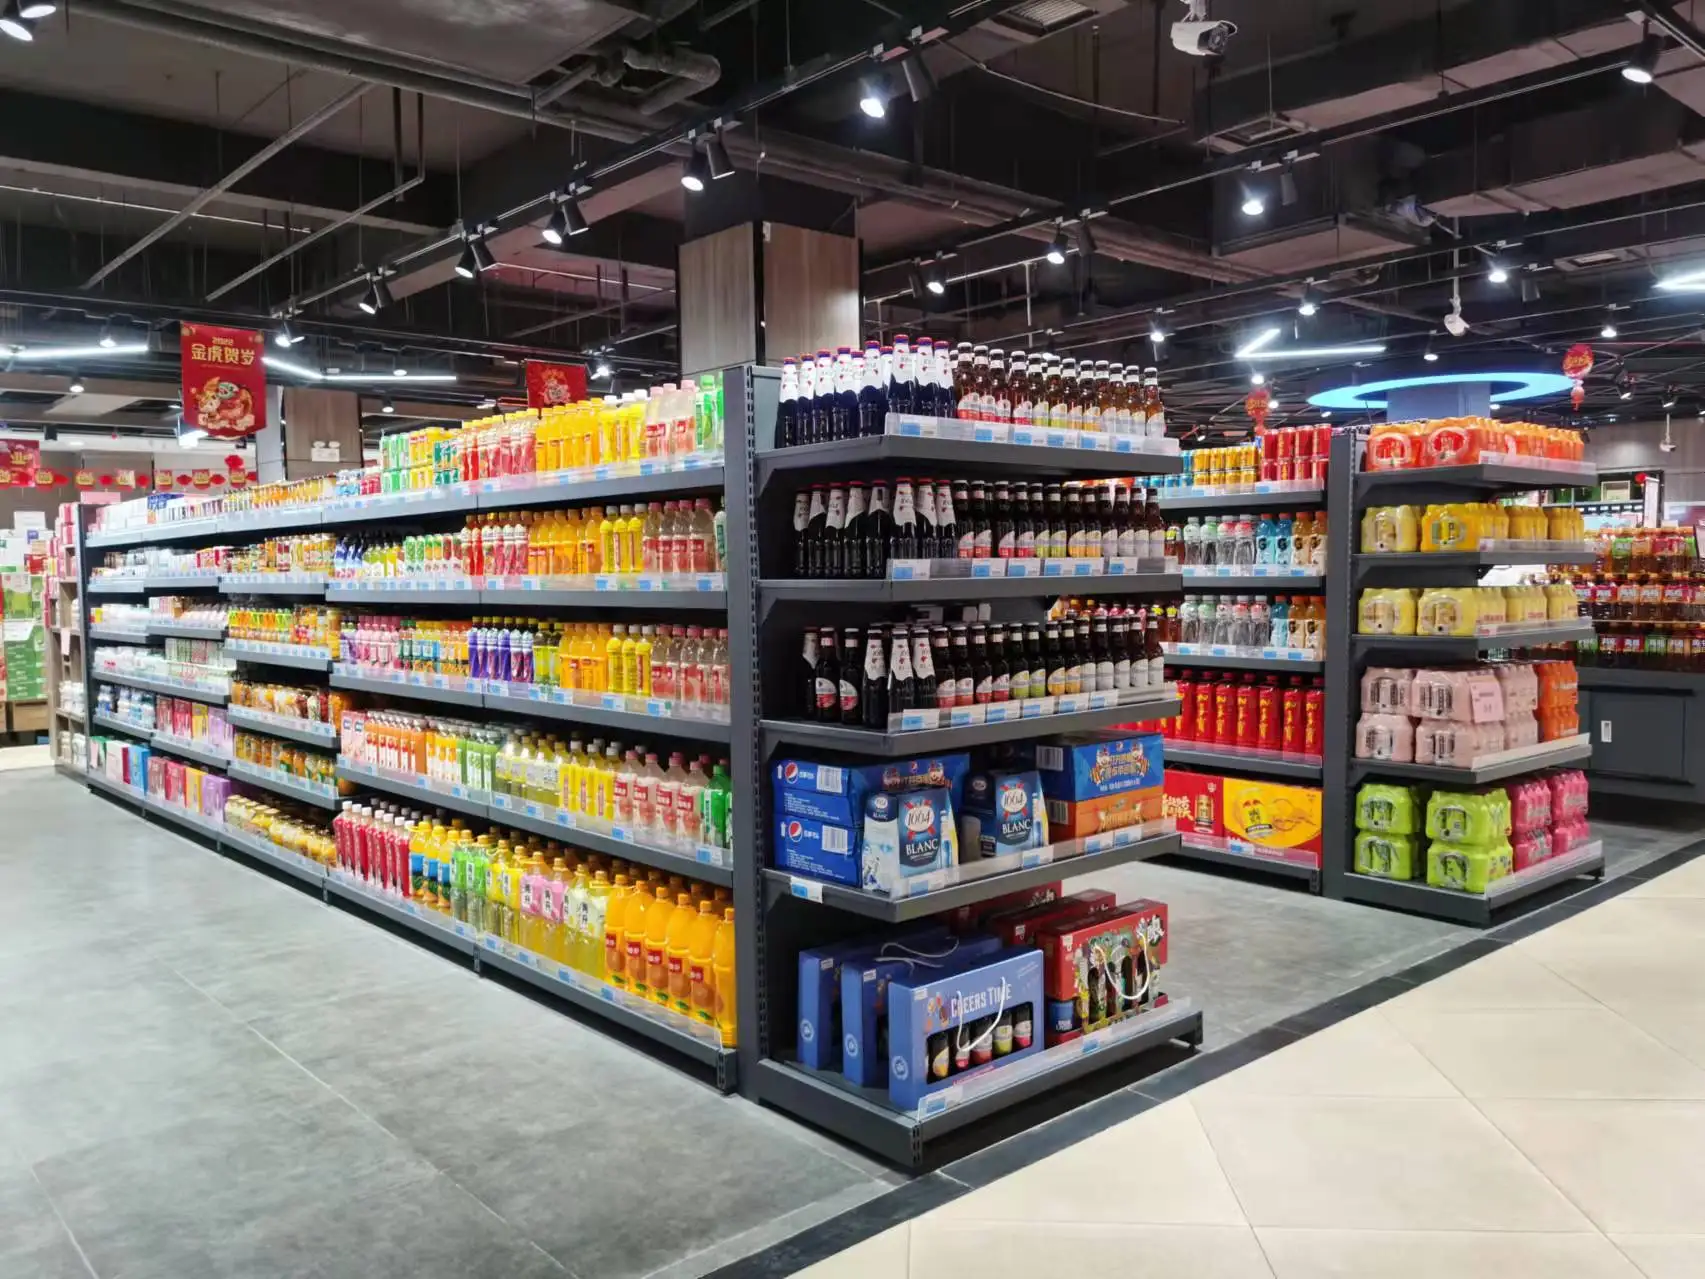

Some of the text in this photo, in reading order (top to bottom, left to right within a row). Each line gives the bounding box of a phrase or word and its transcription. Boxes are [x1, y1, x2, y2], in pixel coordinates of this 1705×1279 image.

[191, 344, 255, 365] 金虎贺岁
[1002, 818, 1032, 834] BLANC
[905, 838, 939, 855] BLANC
